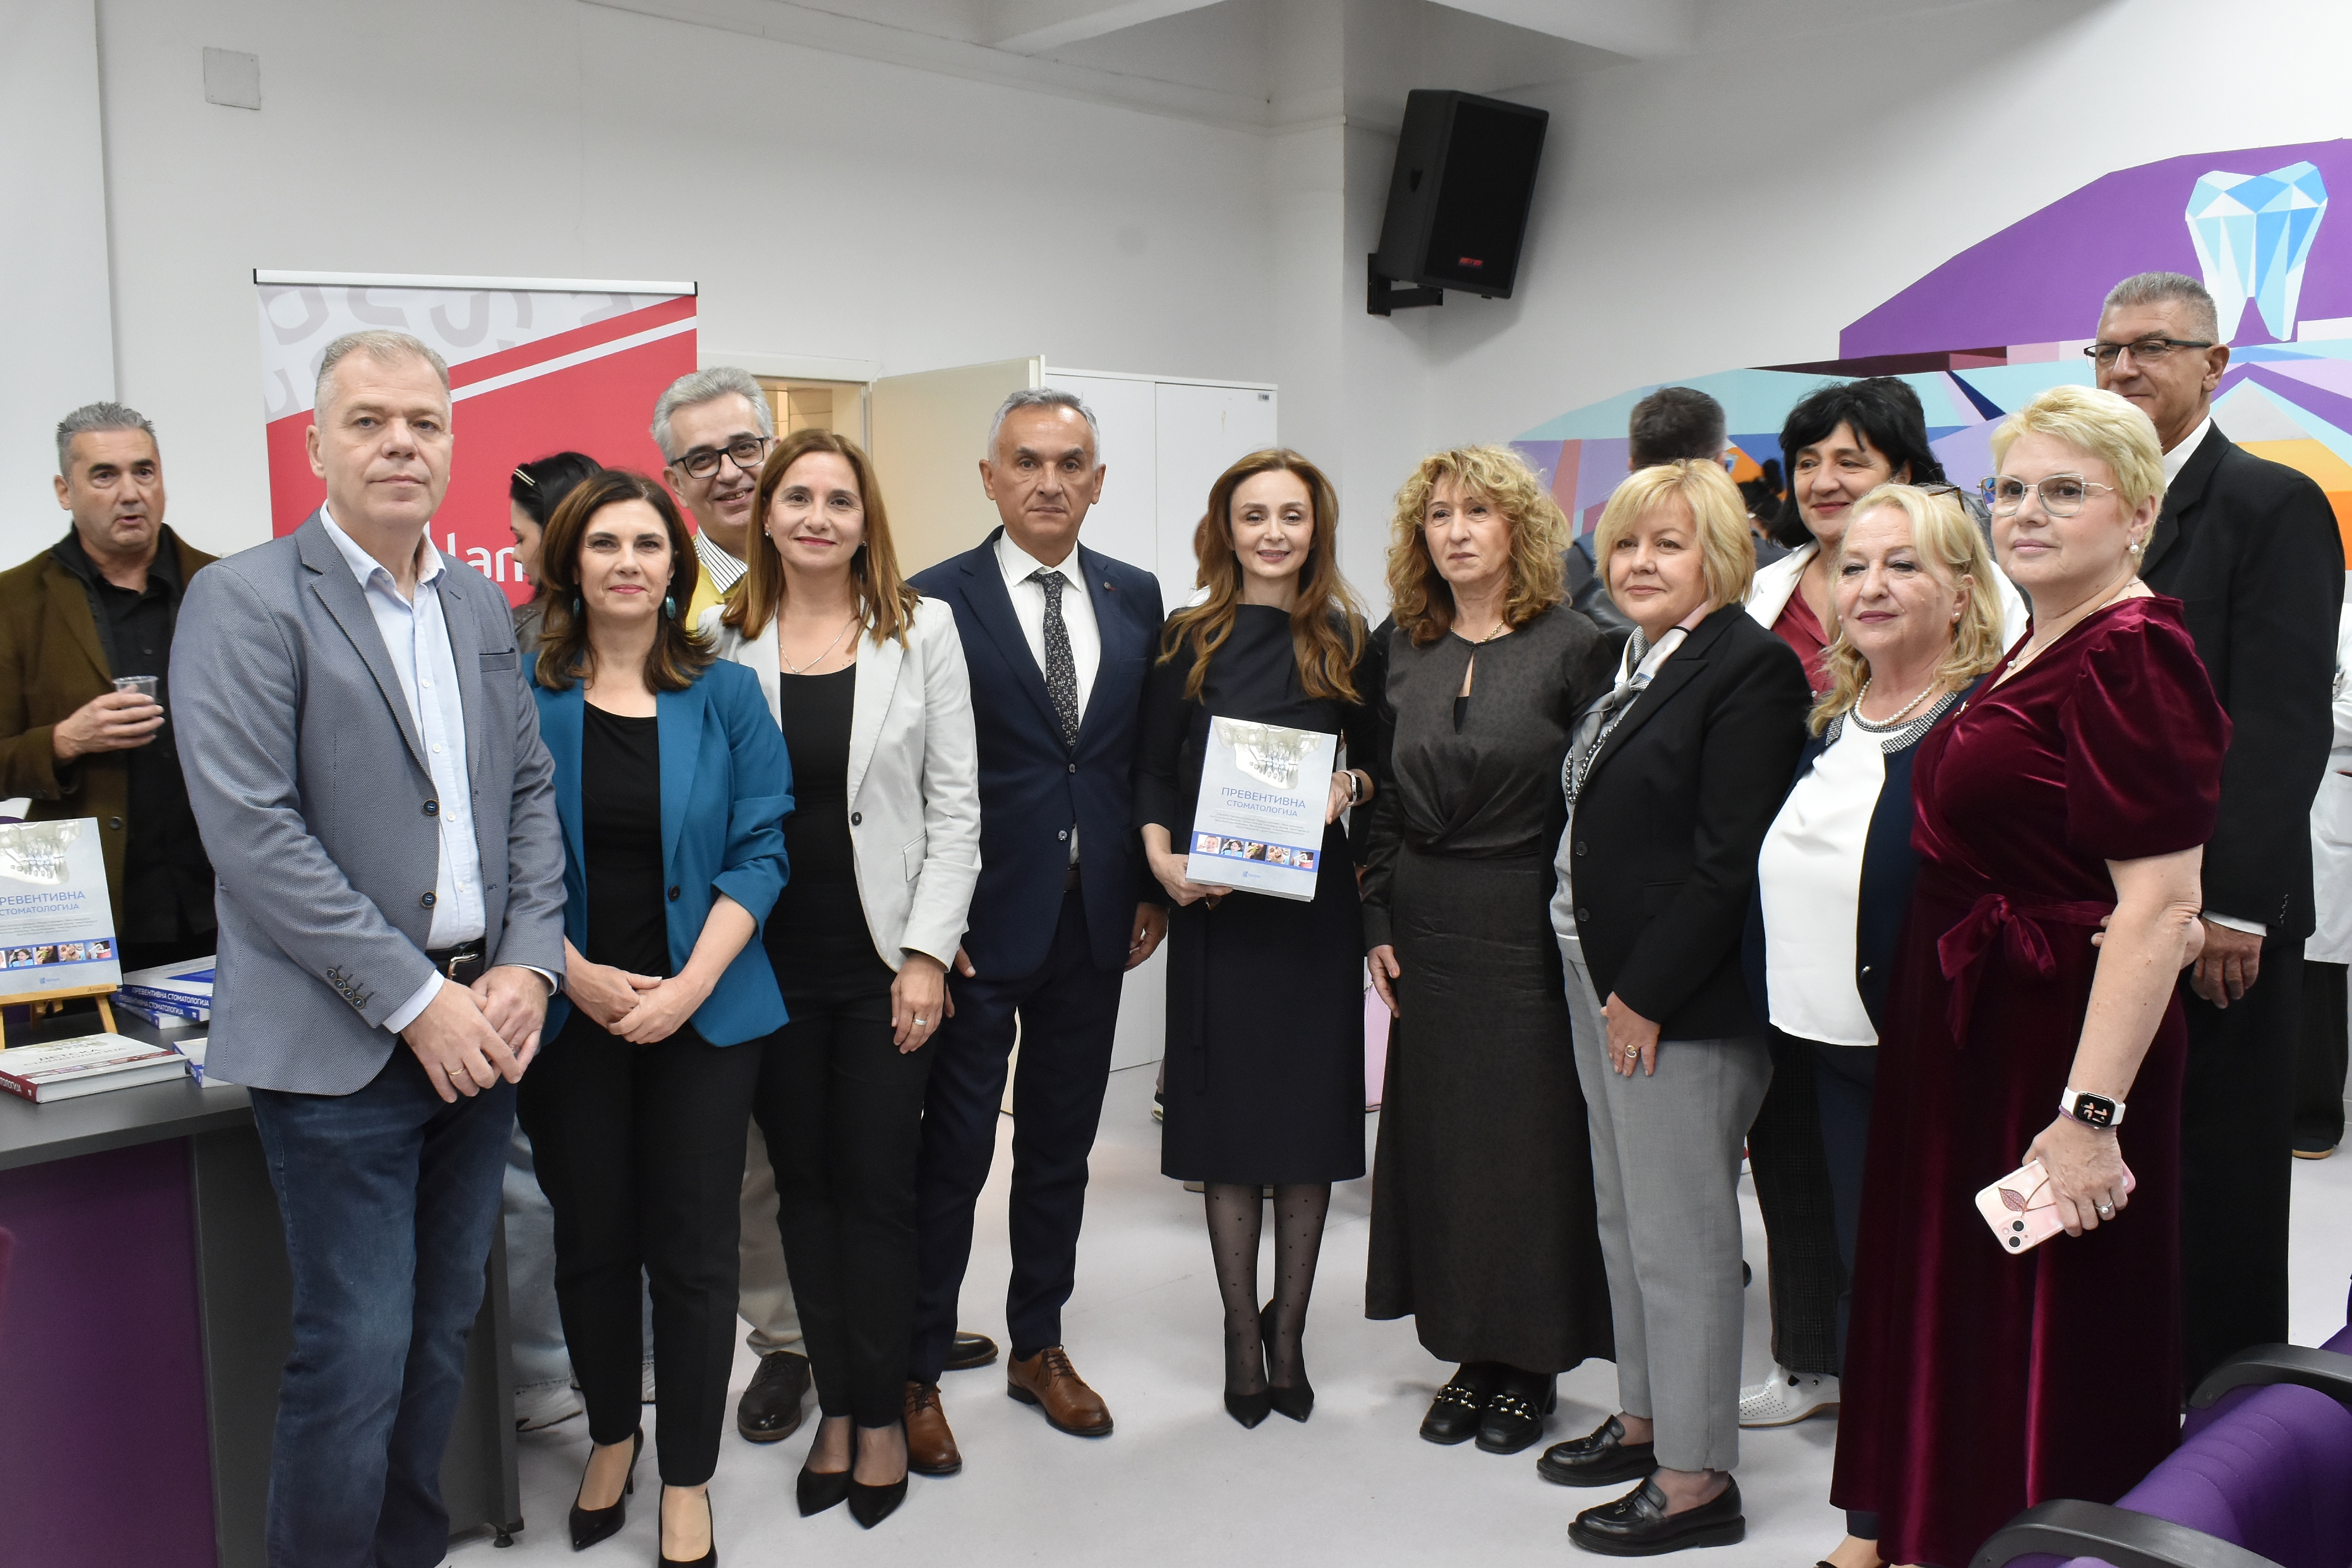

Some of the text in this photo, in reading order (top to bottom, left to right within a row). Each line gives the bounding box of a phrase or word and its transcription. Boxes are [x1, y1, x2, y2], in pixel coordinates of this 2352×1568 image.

[1221, 787, 1306, 808] ПРЕВЕНТИВНА
[1227, 800, 1298, 817] СТОМАТОЛОГИЈА
[0, 903, 80, 916] СТОМАТОЛОГИЈА
[132, 987, 209, 1006] ПРЕВЕНТИВНА СТОМАТОЛОГИЈА
[149, 1001, 184, 1015] СТОМАТОЛОГИЈА
[39, 1049, 101, 1061] ДЕТСКА
